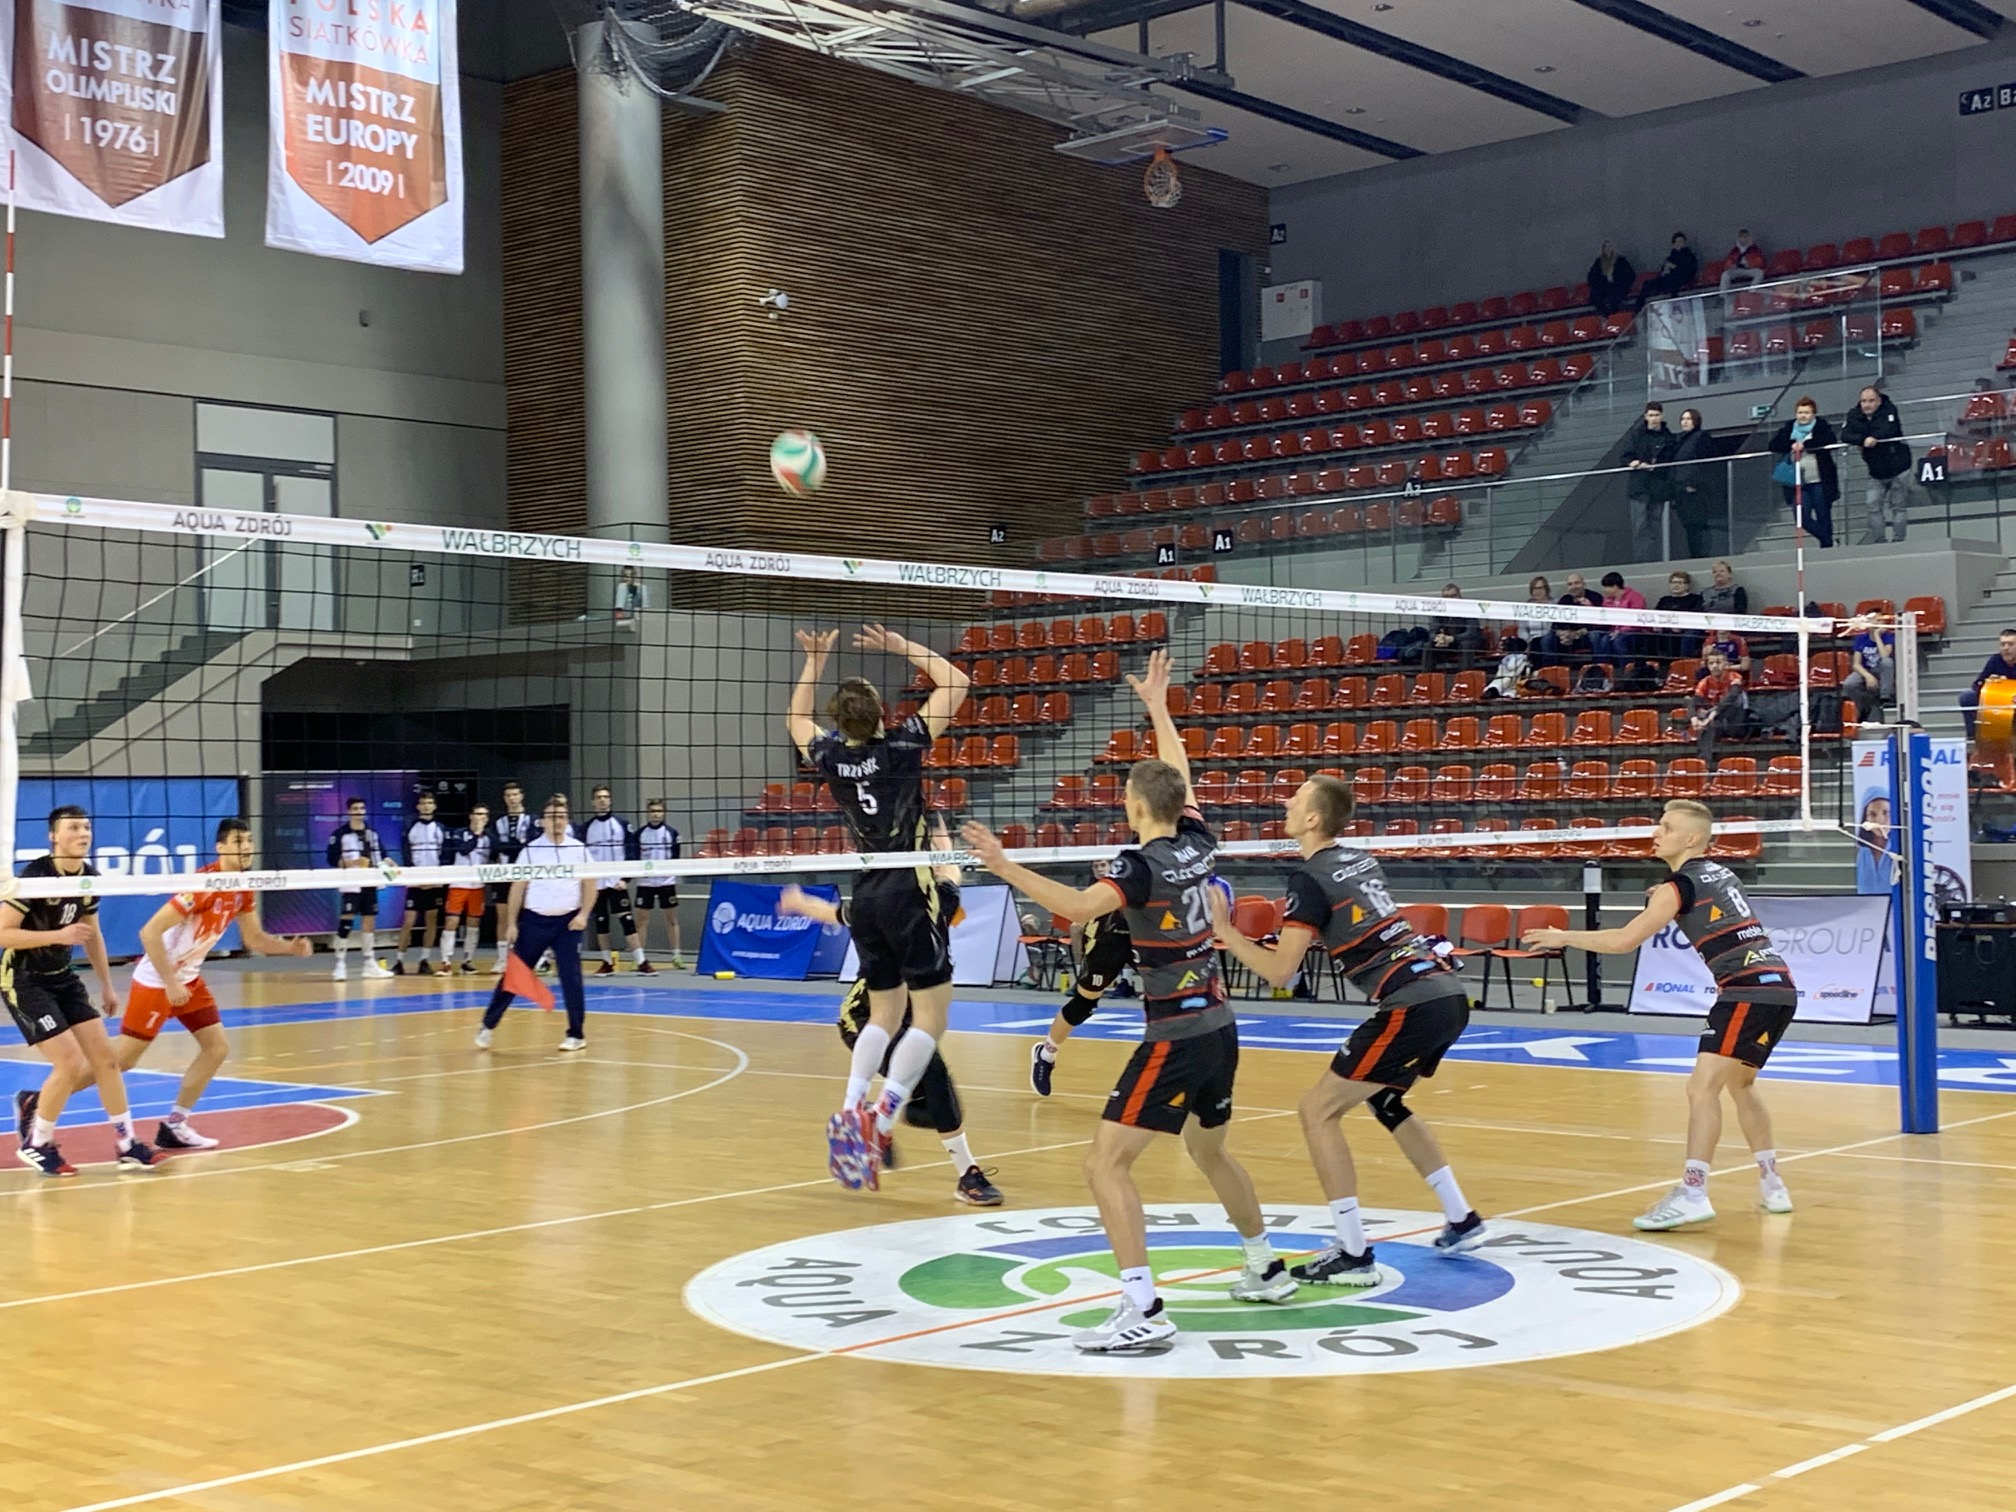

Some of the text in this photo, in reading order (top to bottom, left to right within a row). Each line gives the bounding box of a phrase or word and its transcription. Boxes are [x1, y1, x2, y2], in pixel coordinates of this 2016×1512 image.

[290, 0, 429, 35] OLSKA
[289, 16, 429, 64] SIATKÓWKA
[47, 31, 176, 84] MISTRZ
[45, 70, 176, 116] OLIMPIJSKI
[305, 78, 417, 124] MISTRZ
[1971, 94, 1992, 111] A2
[80, 117, 147, 155] 1976
[306, 114, 418, 160] EUROPY
[338, 162, 393, 192] 2009
[1921, 462, 1945, 482] A1
[172, 512, 292, 536] AQUA ZDRÓJ
[442, 529, 581, 559] WAŁBRZYCH
[1215, 534, 1231, 551] A1
[705, 552, 791, 572] AQUA ZDRÓJ
[1159, 548, 1174, 564] A1
[899, 563, 1000, 587] WAŁBRZYCH
[1093, 579, 1159, 597] AQUA ZDRÓJ
[1242, 587, 1322, 607] WAŁBRZYCH
[1512, 604, 1578, 620] WAŁBRZYCH
[1880, 749, 1962, 767] RAL
[855, 780, 878, 815] 5
[205, 873, 287, 891] AQUA ZDRÓJ
[478, 864, 575, 881] WAŁBRZYCH
[1727, 886, 1751, 918] 8
[60, 903, 77, 924] 18
[737, 913, 773, 932] AQUA
[1767, 927, 1875, 955] GROUP
[1092, 974, 1104, 987] 10
[1655, 982, 1695, 993] RONAL
[37, 1014, 57, 1032] 18
[146, 1011, 161, 1029] 7
[1482, 1234, 1678, 1300] AQUA
[735, 1257, 898, 1327] AQUA
